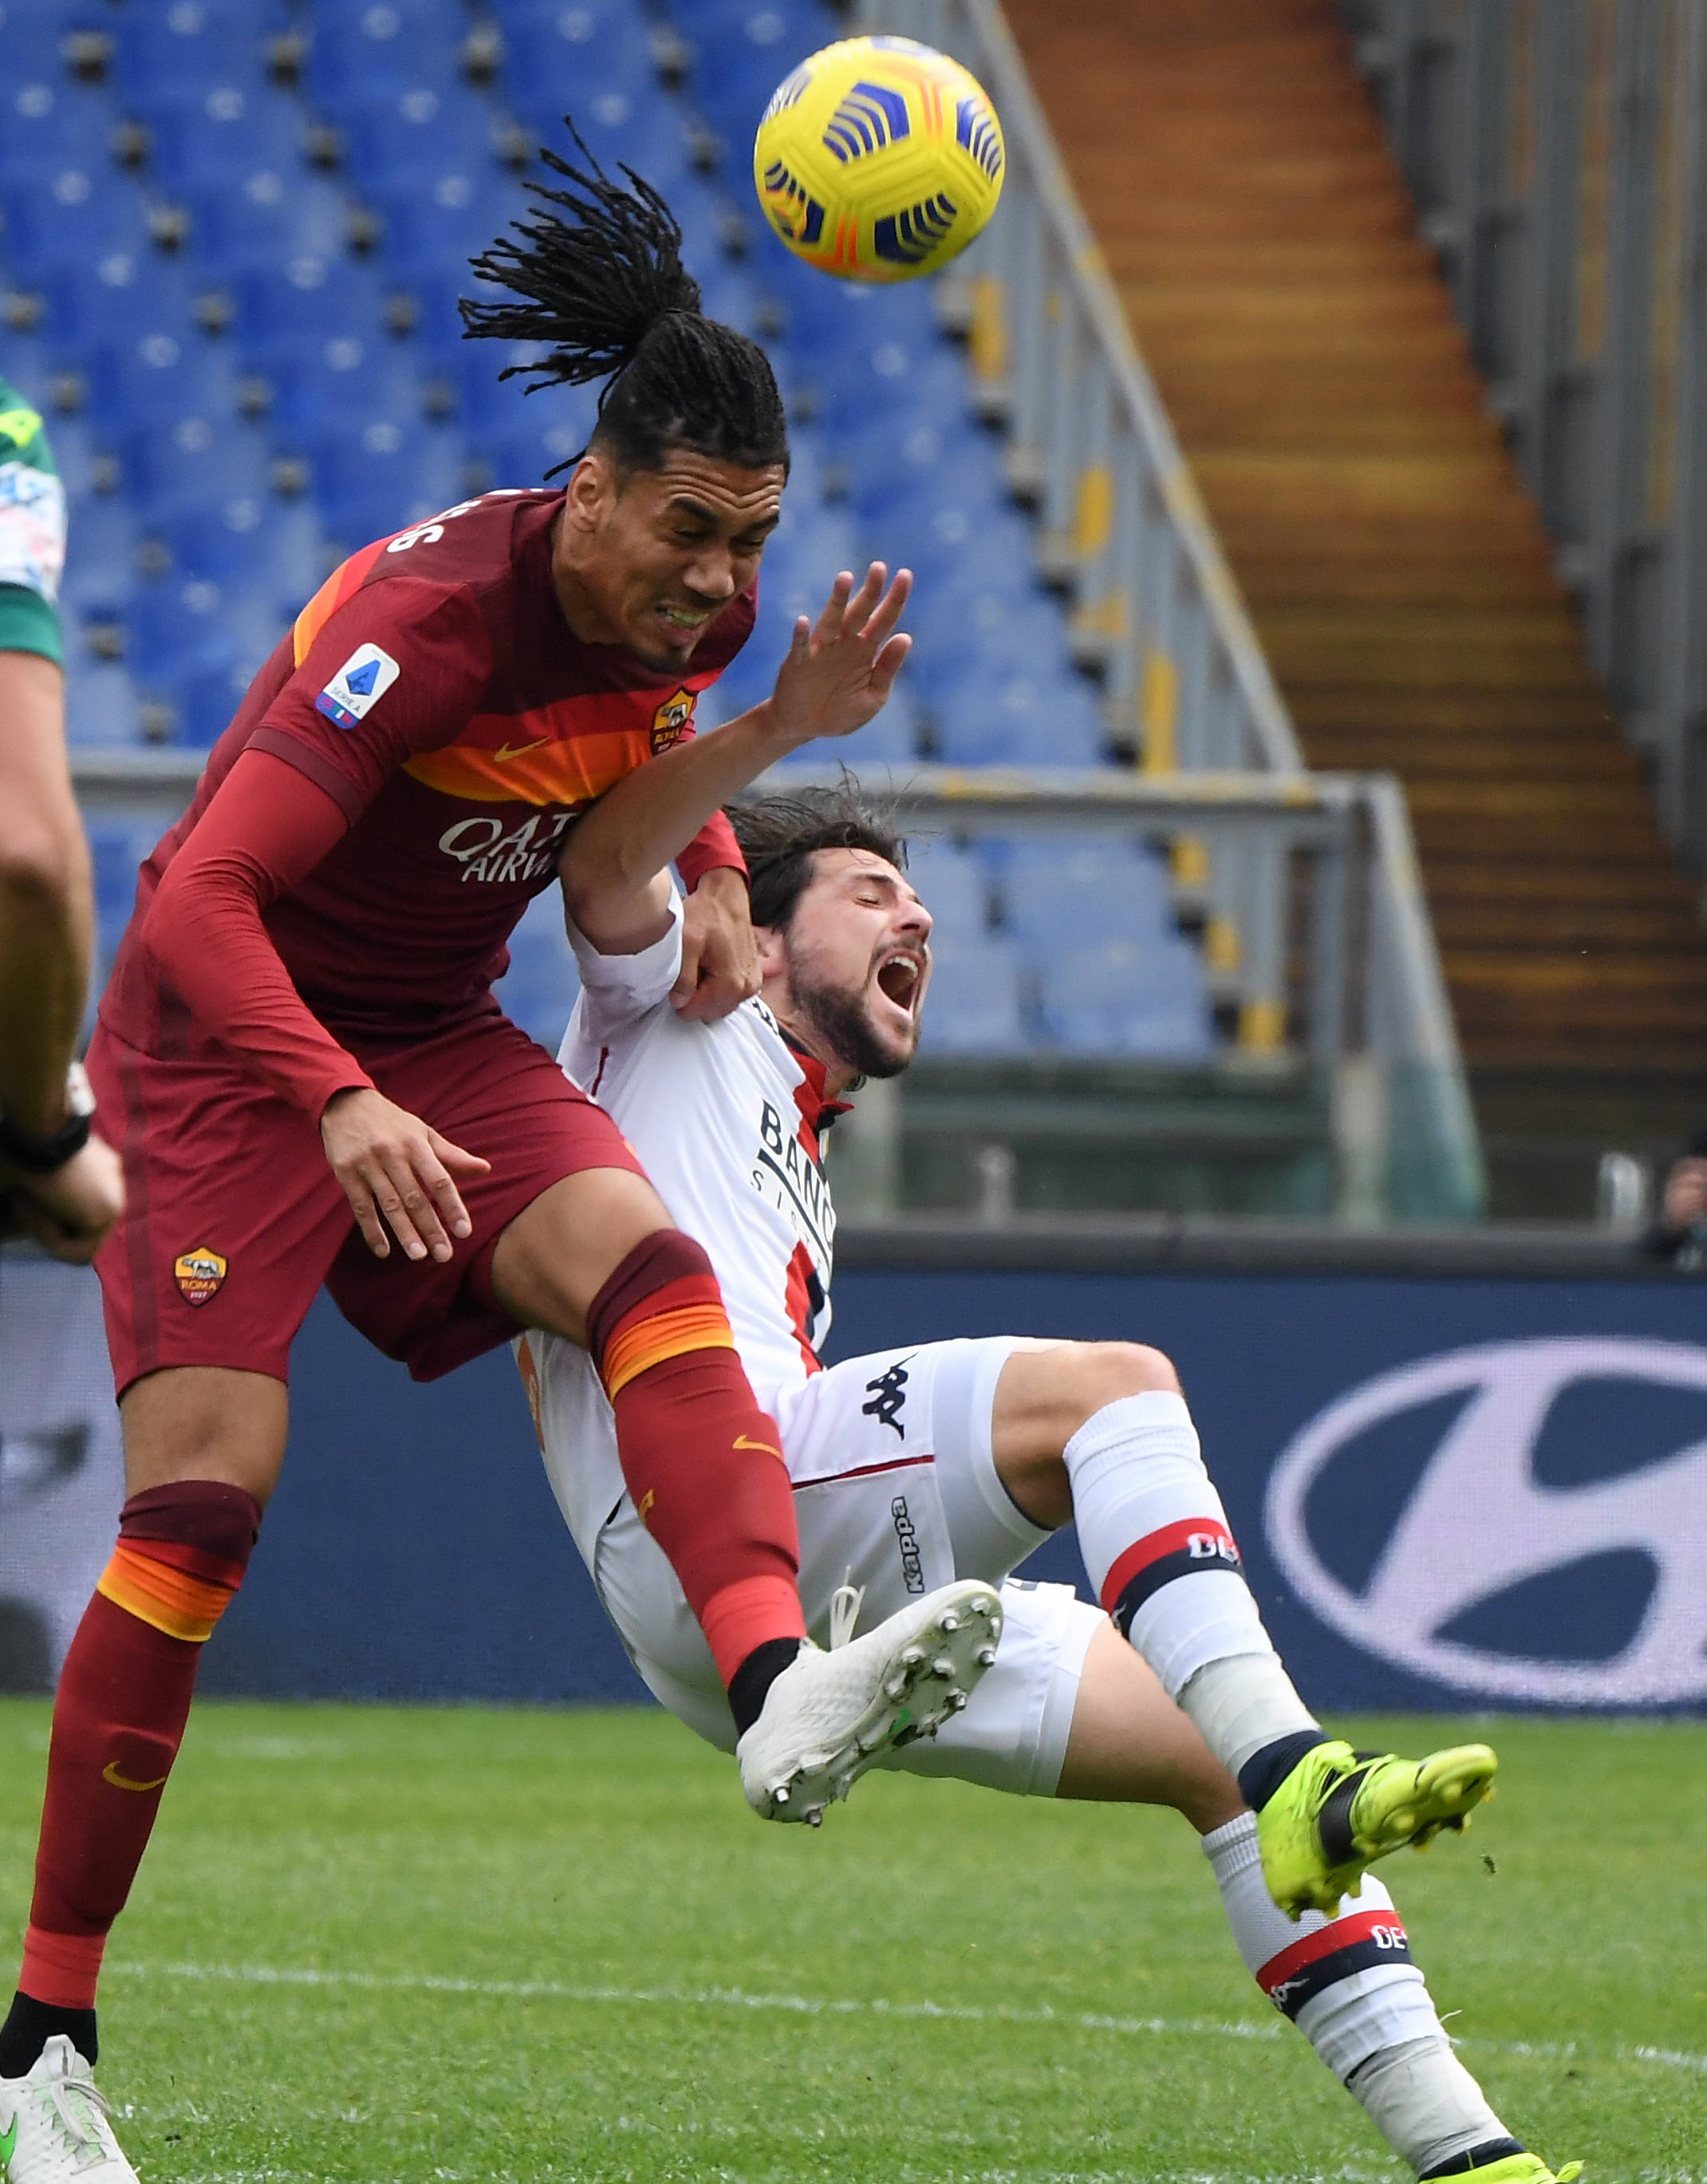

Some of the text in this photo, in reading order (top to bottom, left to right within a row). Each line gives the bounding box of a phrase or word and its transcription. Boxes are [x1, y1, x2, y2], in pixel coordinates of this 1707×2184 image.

[439, 812, 578, 862] QAT
[461, 850, 552, 882] AIRW
[760, 1098, 833, 1251] BANC
[181, 1279, 217, 1290] ROMA
[891, 1496, 924, 1594] Kappa
[1186, 1532, 1240, 1566] GE
[1370, 1924, 1408, 1950] GE
